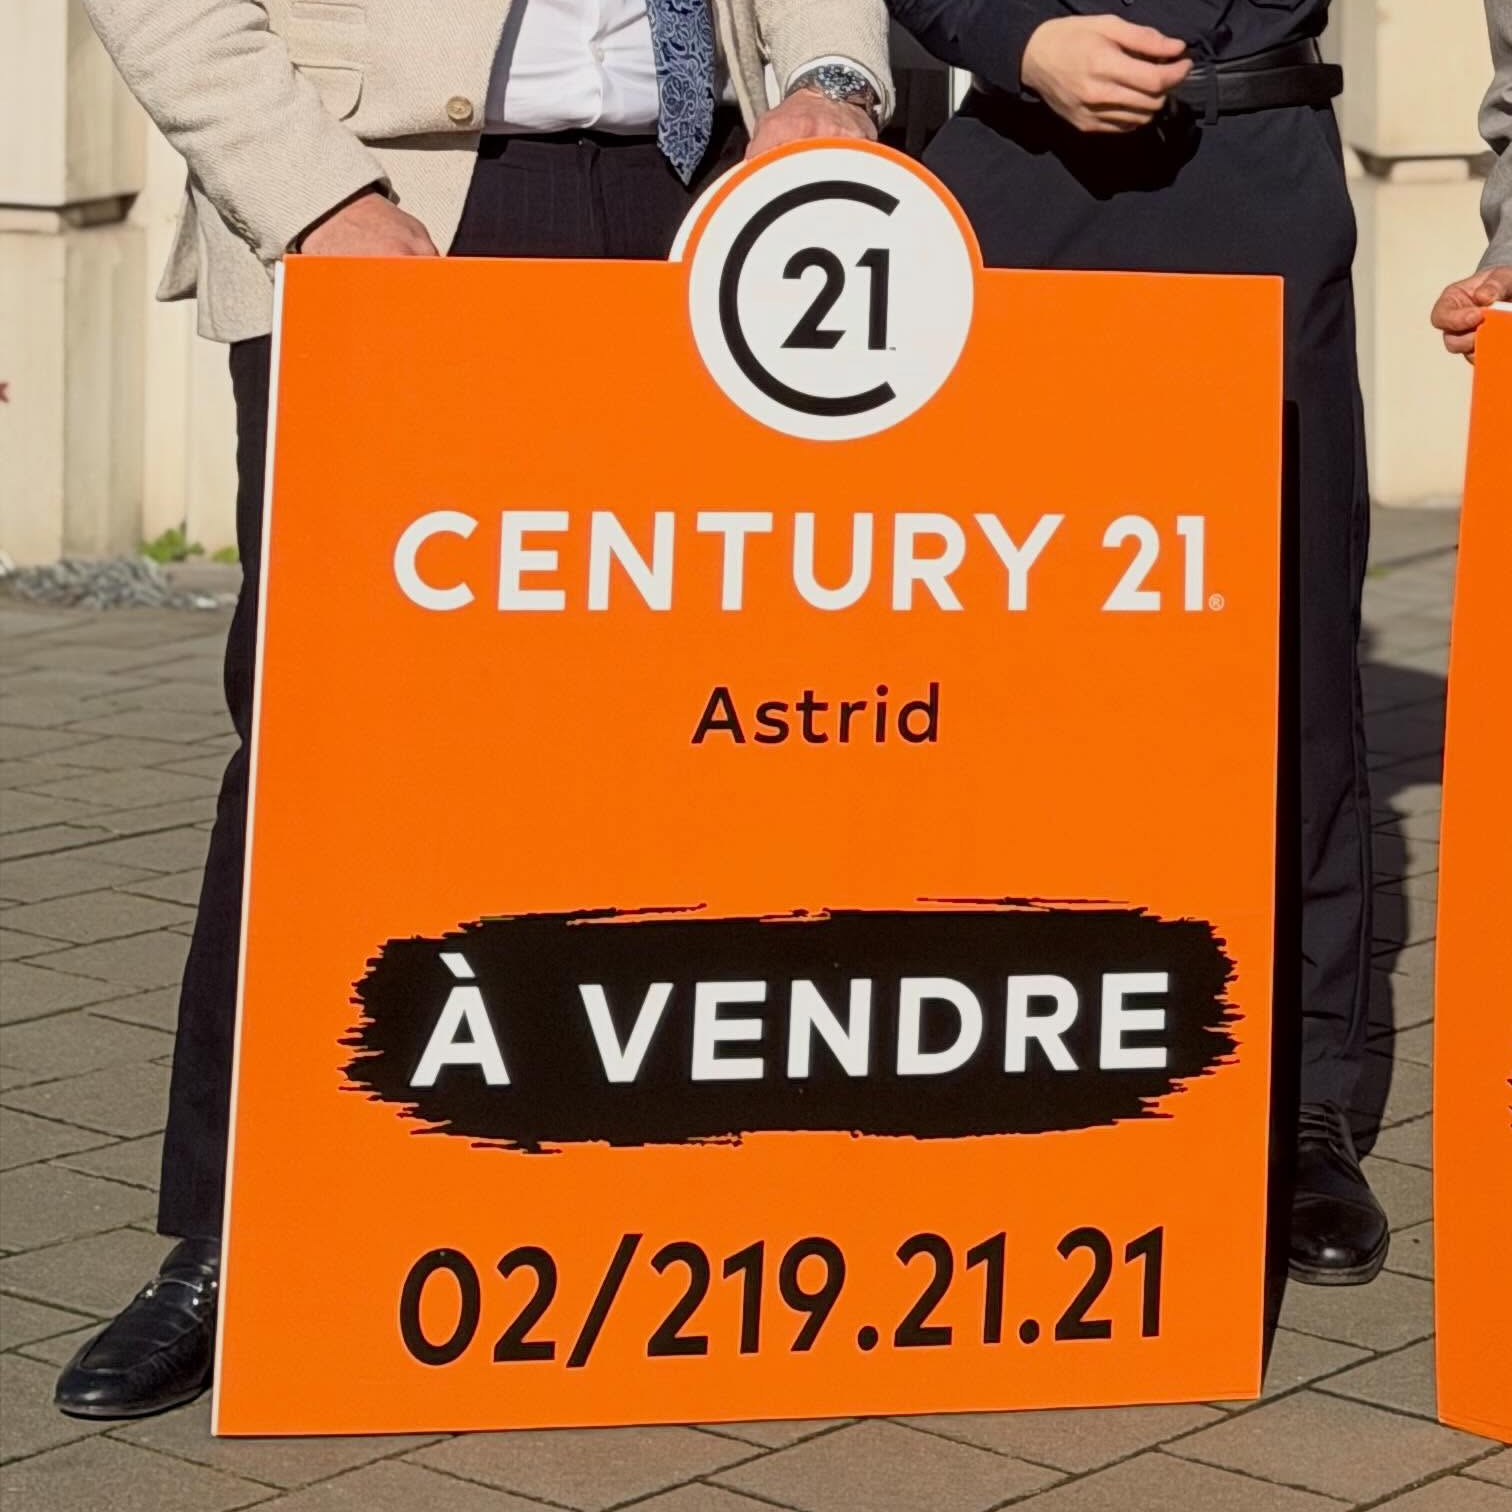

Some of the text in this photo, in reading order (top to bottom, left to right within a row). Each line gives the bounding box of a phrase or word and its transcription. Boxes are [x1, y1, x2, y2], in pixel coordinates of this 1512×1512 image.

[394, 511, 1063, 611] CENTURY
[691, 682, 940, 745] Astrid
[410, 952, 1170, 1087] À VENDRE
[399, 1225, 1165, 1369] 02/219.21.21
